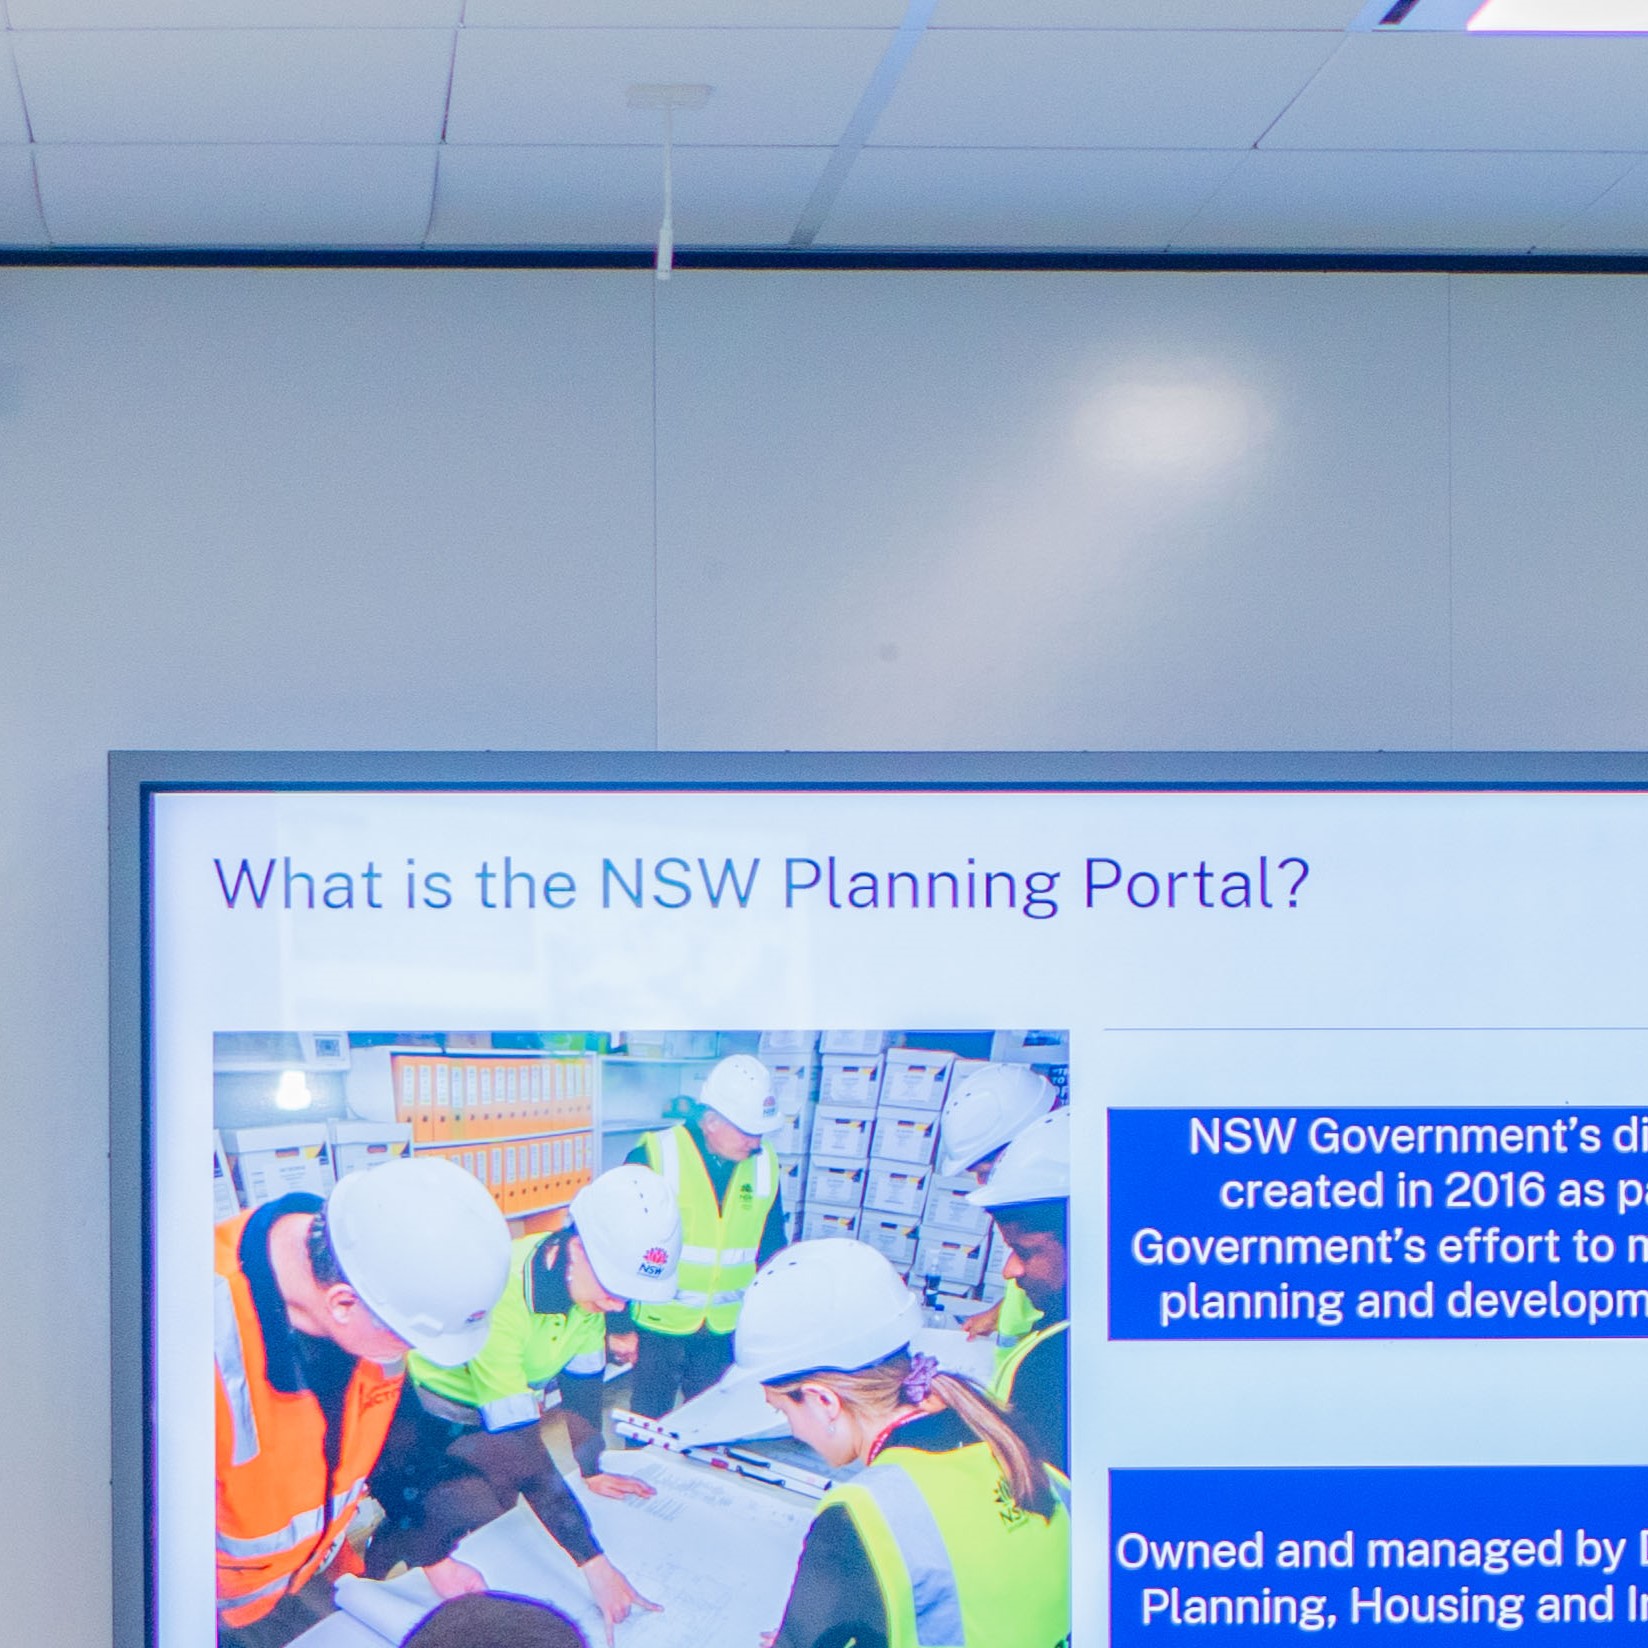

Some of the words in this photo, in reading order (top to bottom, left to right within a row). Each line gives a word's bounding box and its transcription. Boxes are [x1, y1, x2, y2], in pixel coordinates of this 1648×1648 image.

[213, 856, 383, 910] What
[407, 857, 452, 910] is
[475, 856, 577, 910] the
[602, 857, 761, 909] NSW
[785, 856, 1061, 920] Planning
[1085, 856, 1310, 909] Portal?
[1190, 1117, 1297, 1155] NSW
[1309, 1117, 1602, 1155] Government’s
[1219, 1171, 1384, 1209] created
[1397, 1172, 1433, 1208] in
[1445, 1171, 1546, 1208] 2016
[1557, 1178, 1606, 1208] as
[1131, 1227, 1427, 1265] Government’s
[1438, 1226, 1561, 1264] effort
[1572, 1229, 1616, 1263] to
[1160, 1281, 1345, 1327] planning
[1356, 1281, 1434, 1319] and
[1116, 1531, 1264, 1570] Owned
[1276, 1530, 1354, 1569] and
[1367, 1529, 1563, 1575] managed
[1576, 1528, 1627, 1575] by
[1142, 1587, 1337, 1632] Planning,
[1351, 1586, 1526, 1631] Housing
[1536, 1585, 1614, 1623] and
